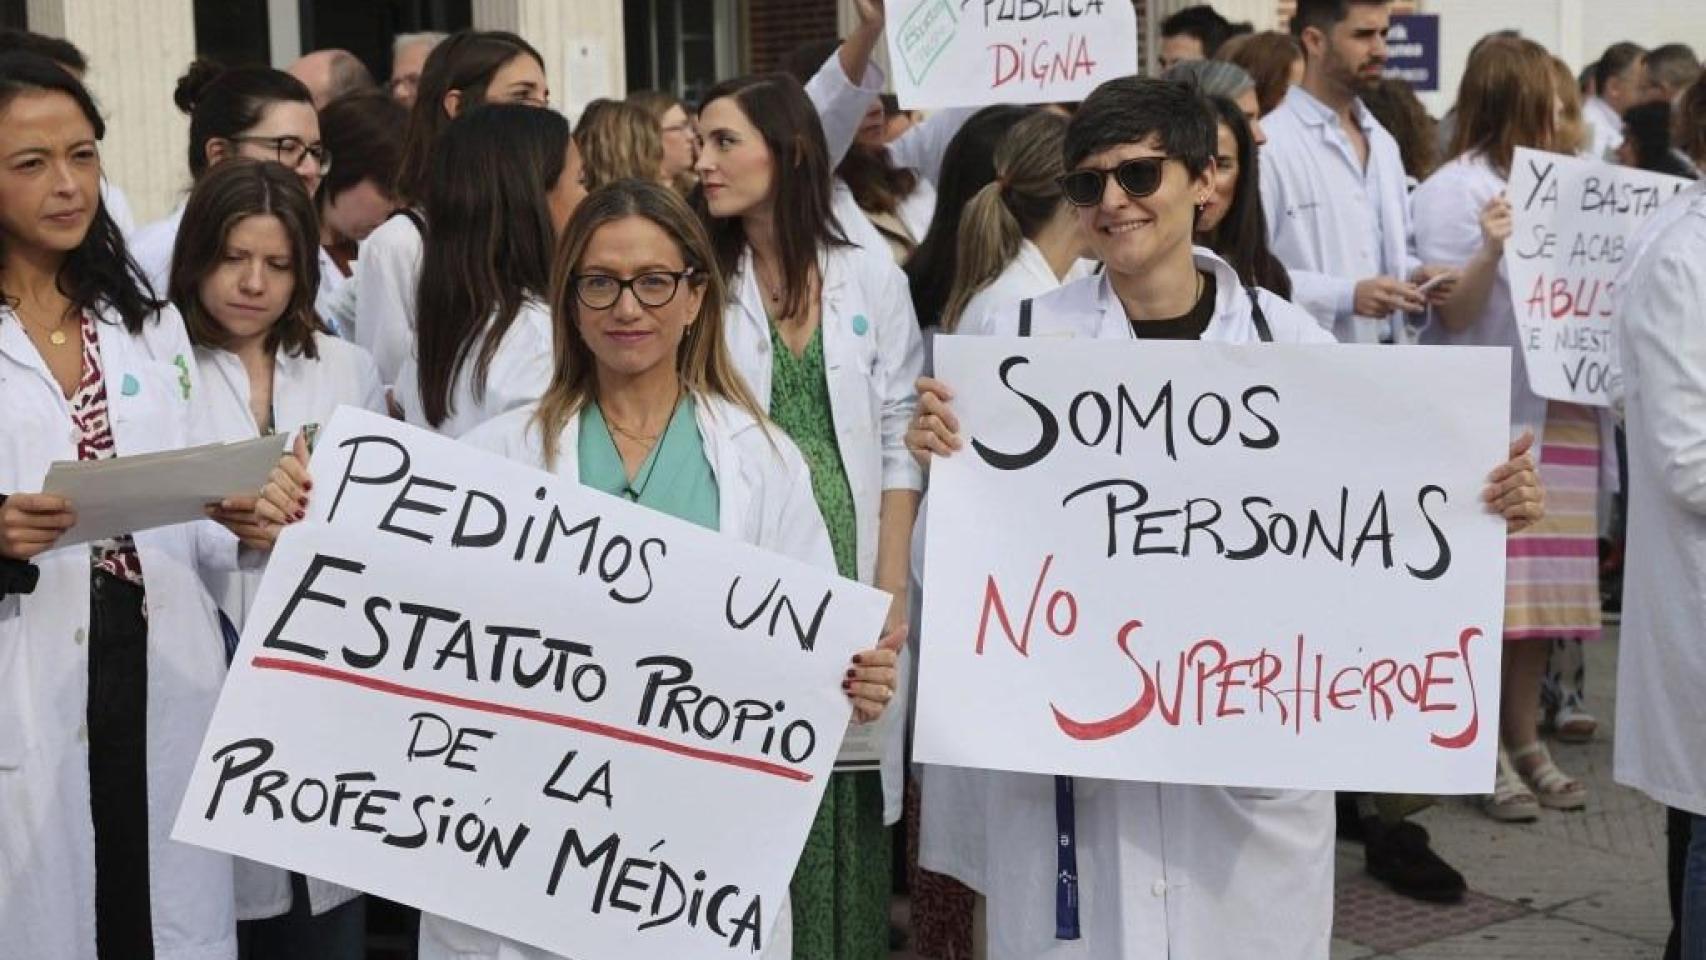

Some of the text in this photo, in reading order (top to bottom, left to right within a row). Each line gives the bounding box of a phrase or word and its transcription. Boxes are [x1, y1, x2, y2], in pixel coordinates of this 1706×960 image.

[1524, 159, 1559, 211] YA
[1517, 224, 1625, 266] SE ACAB
[1525, 272, 1615, 319] ABUS
[1555, 325, 1611, 352] NUEST
[1562, 355, 1611, 393] VOC
[970, 355, 1281, 471] SOMOS
[1062, 479, 1452, 581] PERSONAS
[262, 553, 607, 702] ESTATUTO
[724, 575, 832, 652] UN
[975, 554, 1079, 658] NO
[407, 712, 613, 808] DE LA
